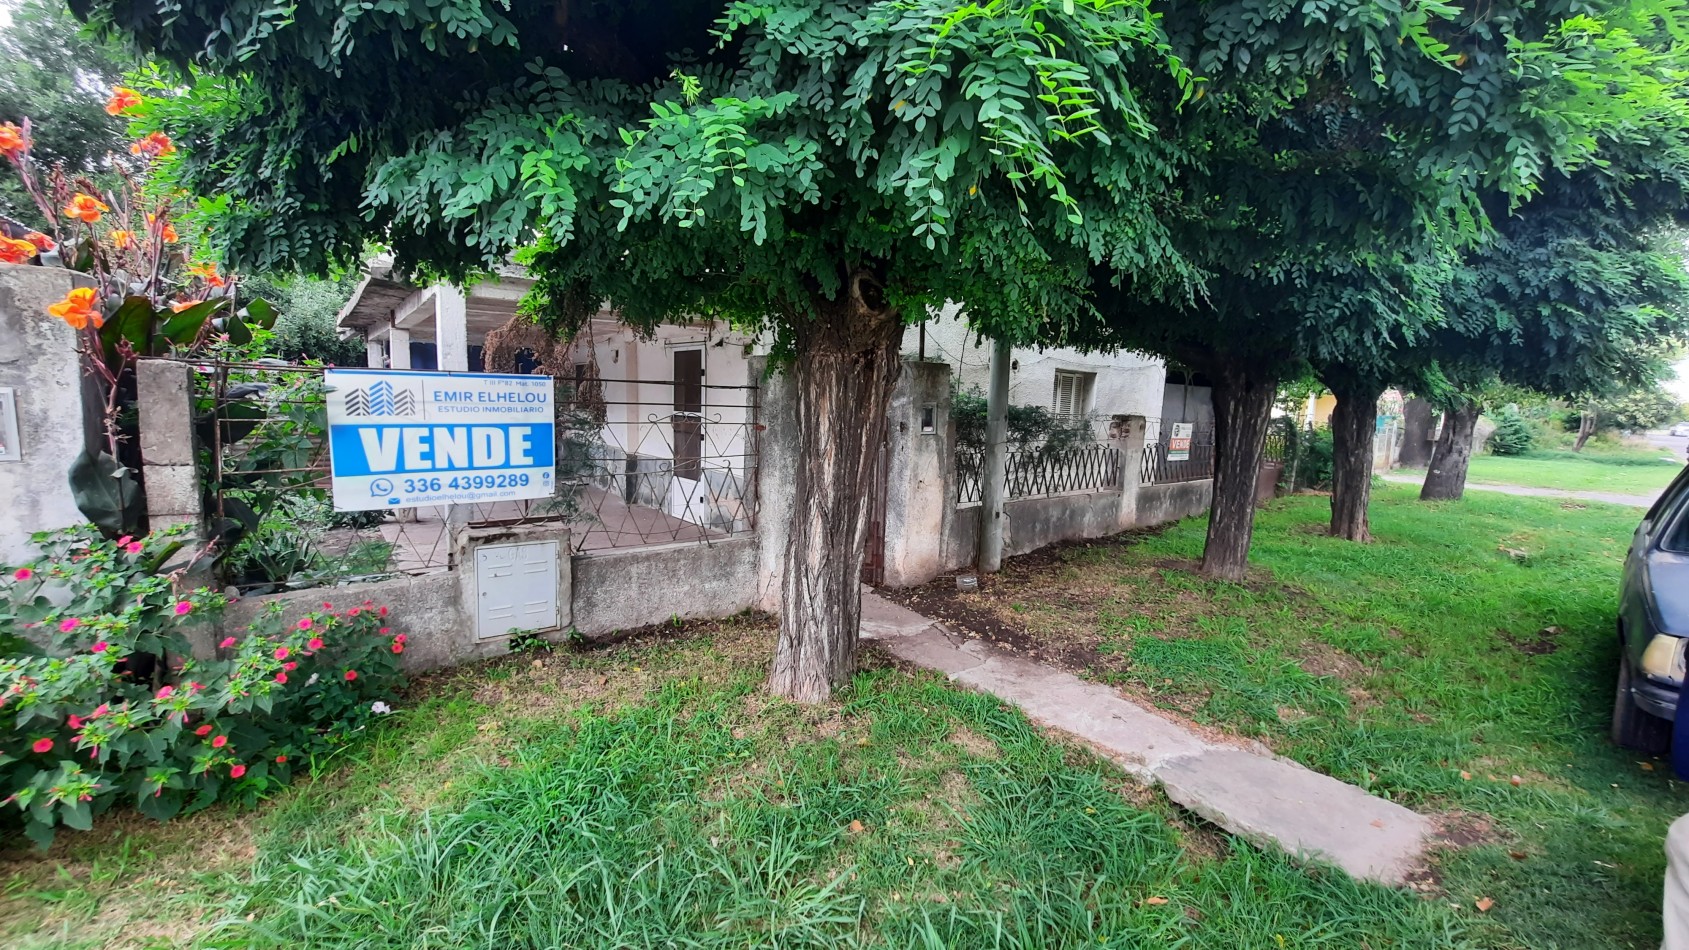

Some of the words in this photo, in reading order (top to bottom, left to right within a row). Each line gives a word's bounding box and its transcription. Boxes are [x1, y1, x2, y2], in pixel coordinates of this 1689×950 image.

[433, 390, 473, 402] EMIR
[478, 391, 547, 403] ELHELOU
[438, 405, 480, 413] ESTUDIO
[358, 426, 534, 472] VENDE
[1172, 439, 1190, 449] VENDE
[404, 477, 441, 494] 336
[448, 473, 530, 490] 4399289
[405, 490, 516, 503] estudioelhelou@gmail.com
